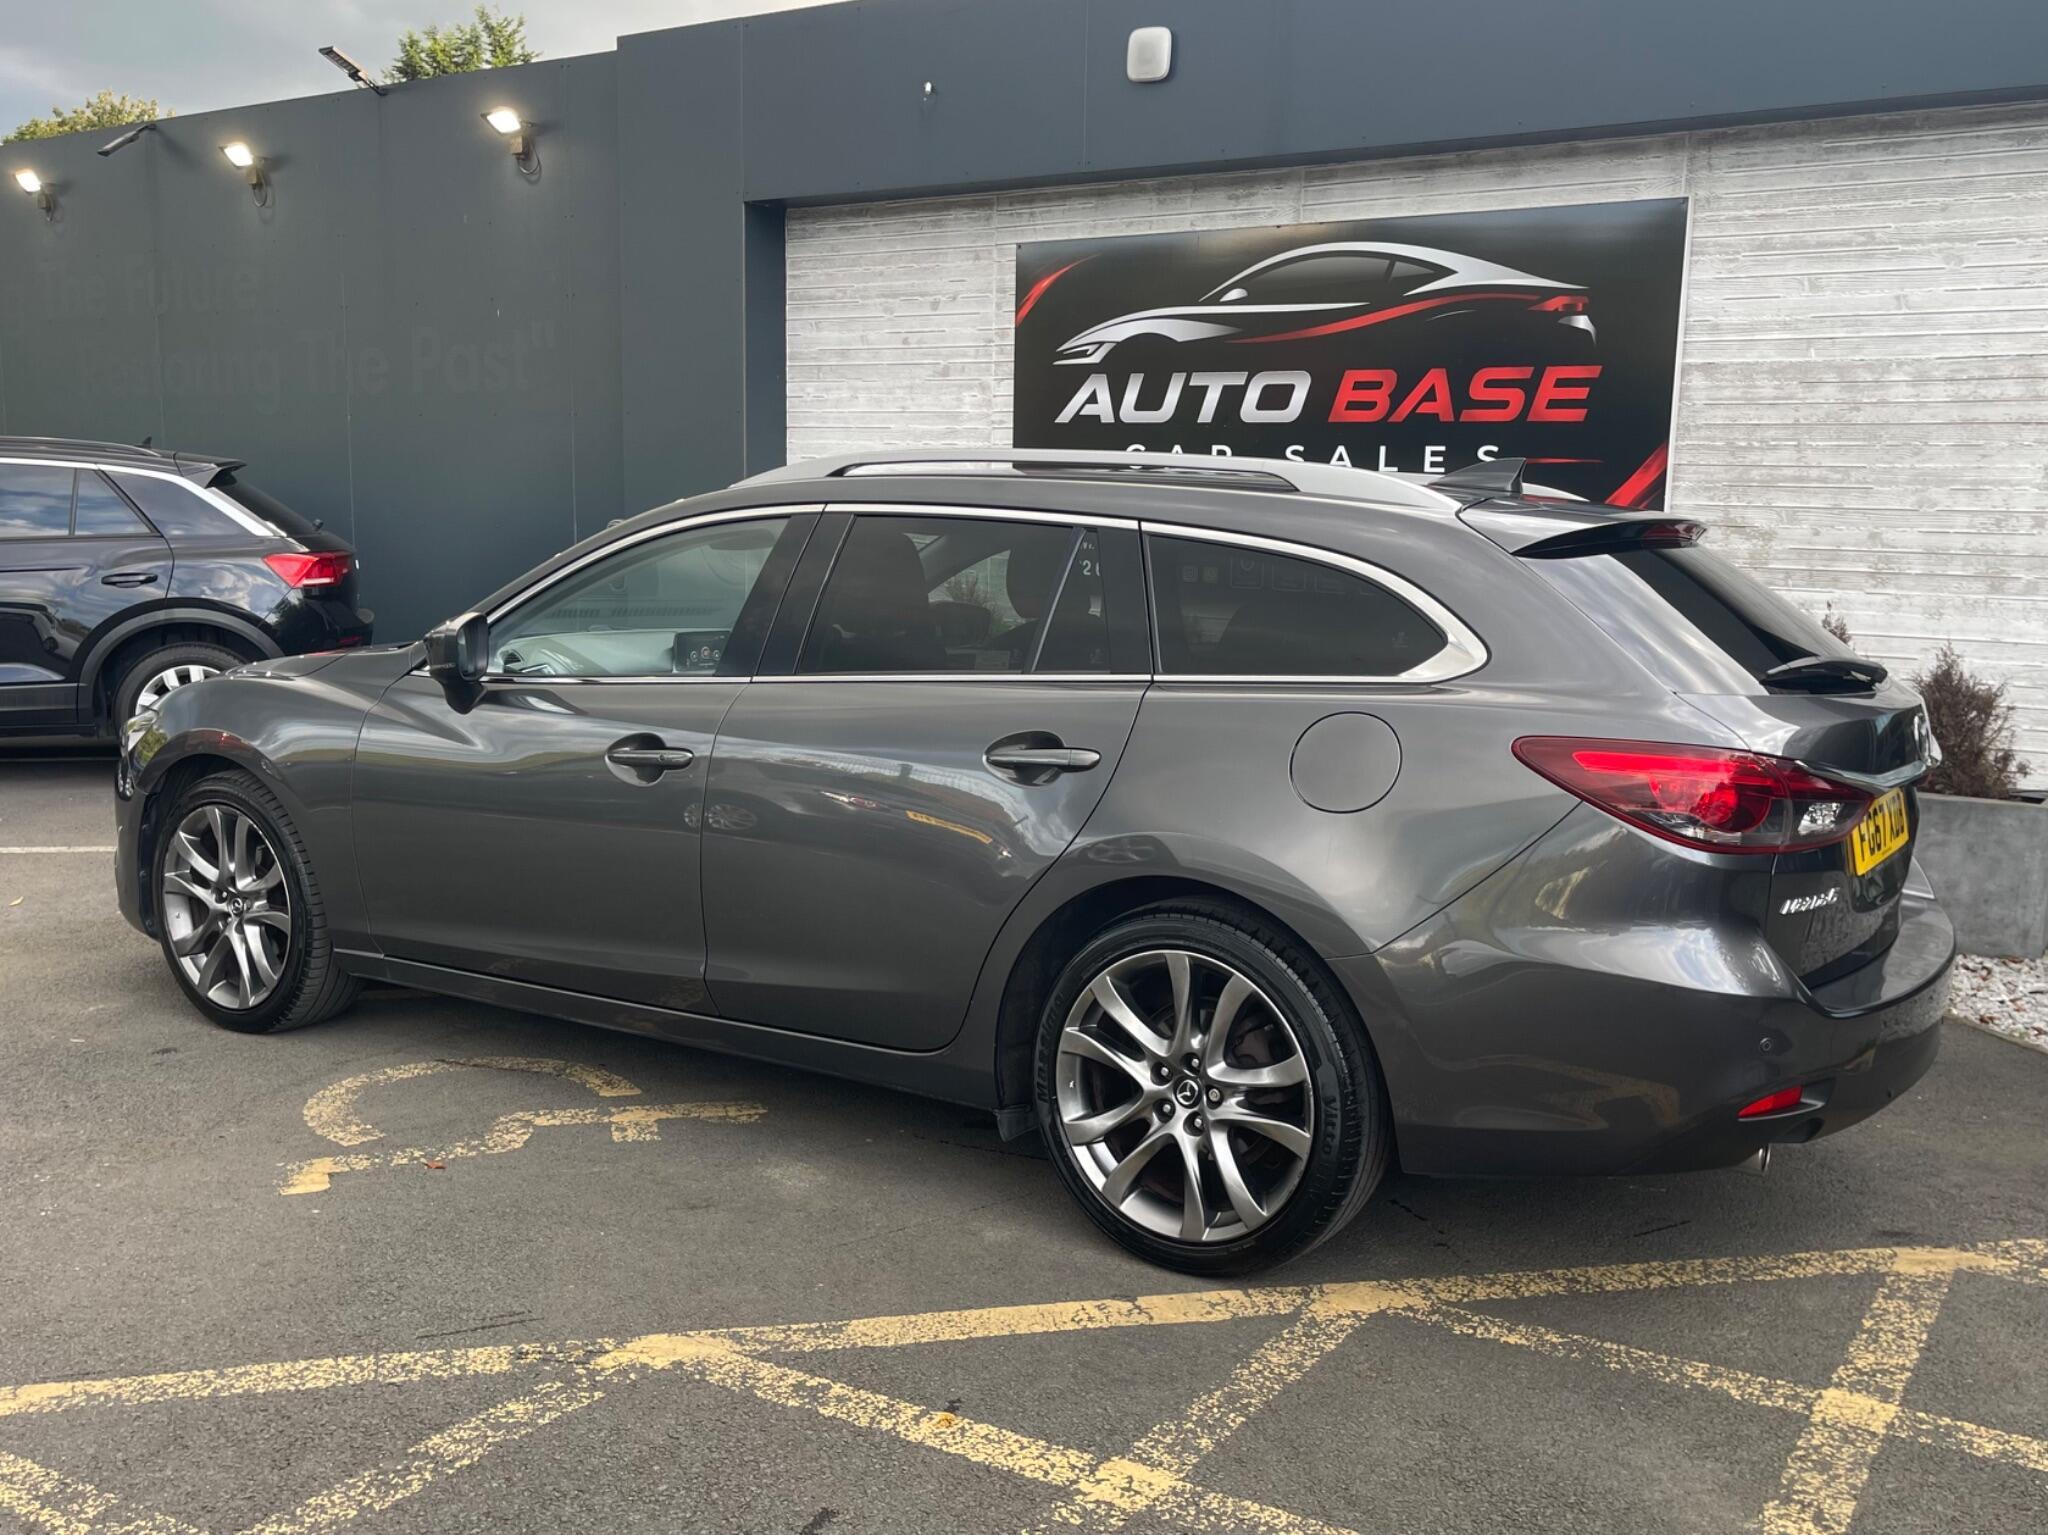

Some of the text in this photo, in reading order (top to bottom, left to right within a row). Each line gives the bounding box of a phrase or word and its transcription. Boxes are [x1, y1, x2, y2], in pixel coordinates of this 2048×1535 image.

[295, 328, 389, 395] The
[1053, 364, 1603, 424] AUTO BASE
[1285, 444, 1501, 473] SALES
